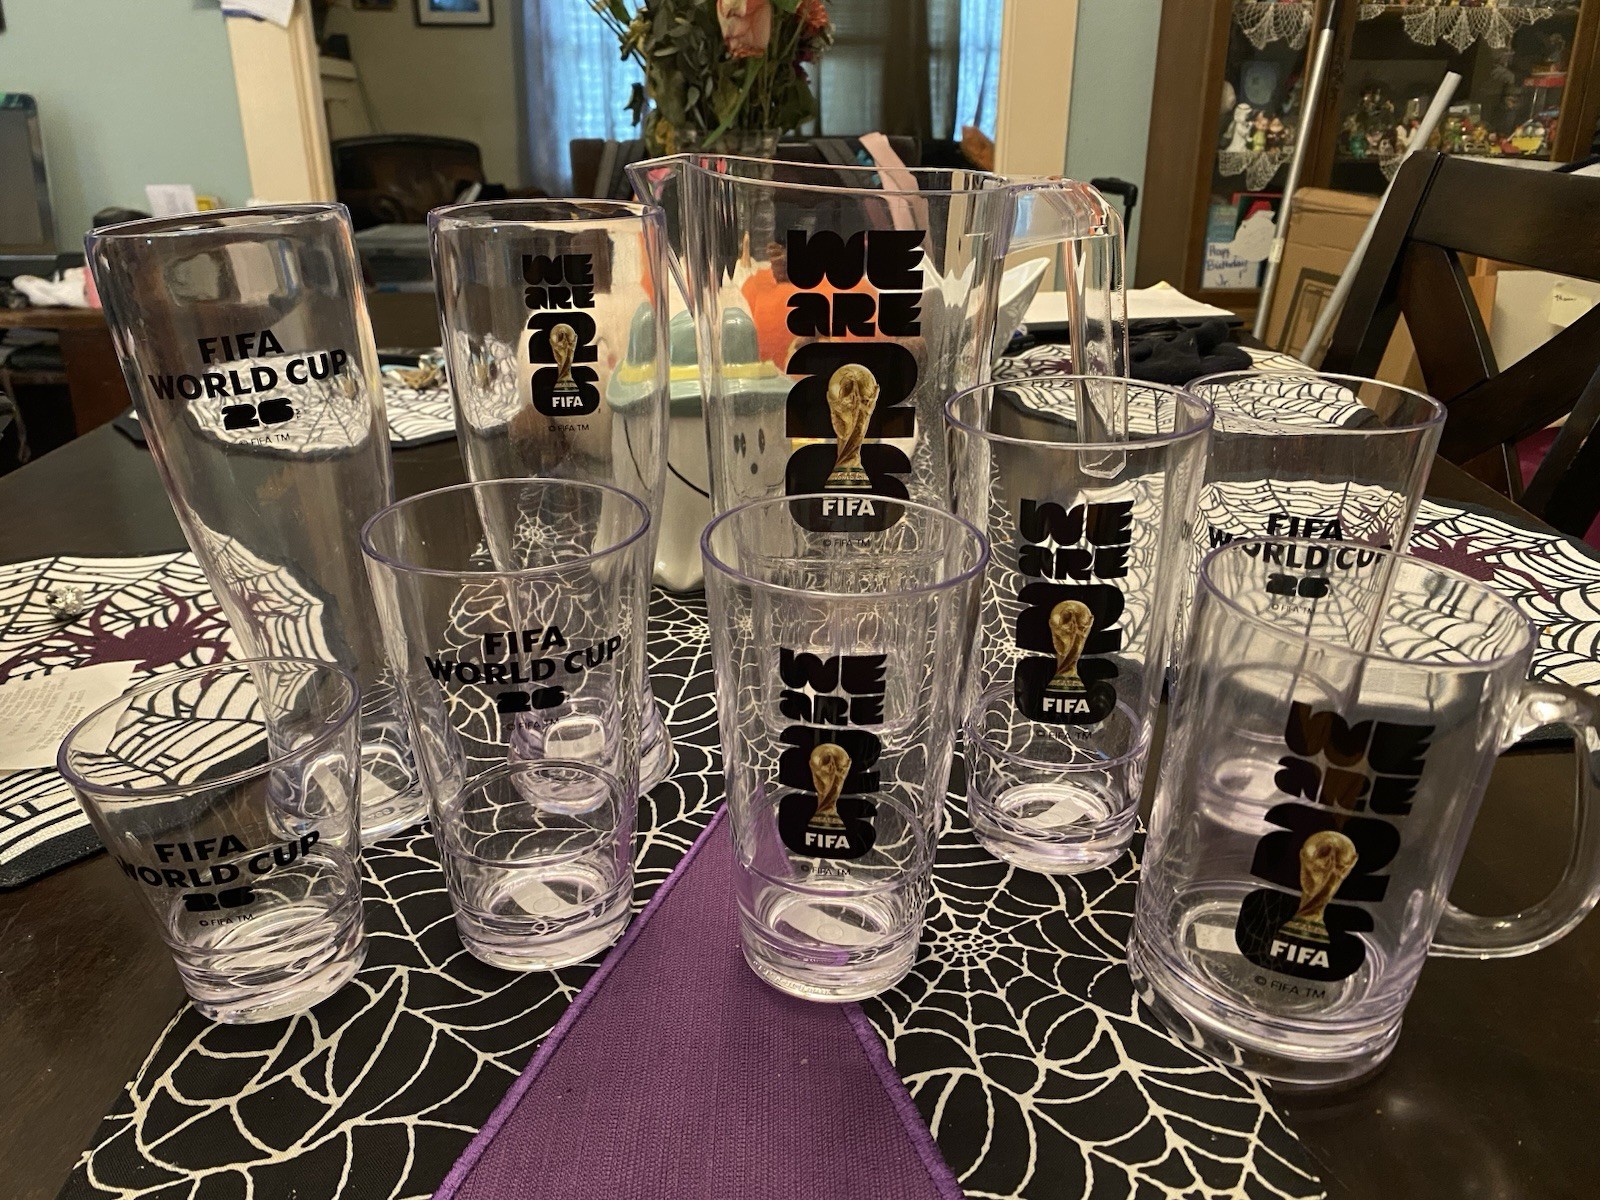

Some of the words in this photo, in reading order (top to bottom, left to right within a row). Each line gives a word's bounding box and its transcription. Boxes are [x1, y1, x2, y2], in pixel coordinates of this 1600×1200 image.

[522, 254, 594, 285] WE
[787, 230, 926, 290] WE
[197, 329, 285, 364] FIFA
[148, 366, 279, 401] WORLD
[286, 349, 348, 386] CUP
[221, 397, 295, 430] 26
[552, 396, 583, 408] FIFA
[822, 497, 876, 517] FIFA
[1020, 498, 1135, 546] WE
[1267, 513, 1343, 541] FIFA
[483, 626, 567, 655] FIFA
[424, 655, 556, 685] WORLD
[564, 635, 622, 674] CUP
[779, 647, 888, 695] WE
[1042, 697, 1090, 714] FIFA
[1284, 700, 1436, 775] WE
[153, 834, 249, 863] FIFA
[804, 832, 850, 849] FIFA
[114, 855, 240, 888] WORLD
[249, 830, 320, 875] CUP
[210, 916, 234, 927] FIFA
[236, 913, 256, 922] TM
[1269, 939, 1330, 969] FIFA
[1271, 980, 1300, 995] FIFA
[1305, 986, 1326, 999] TM
